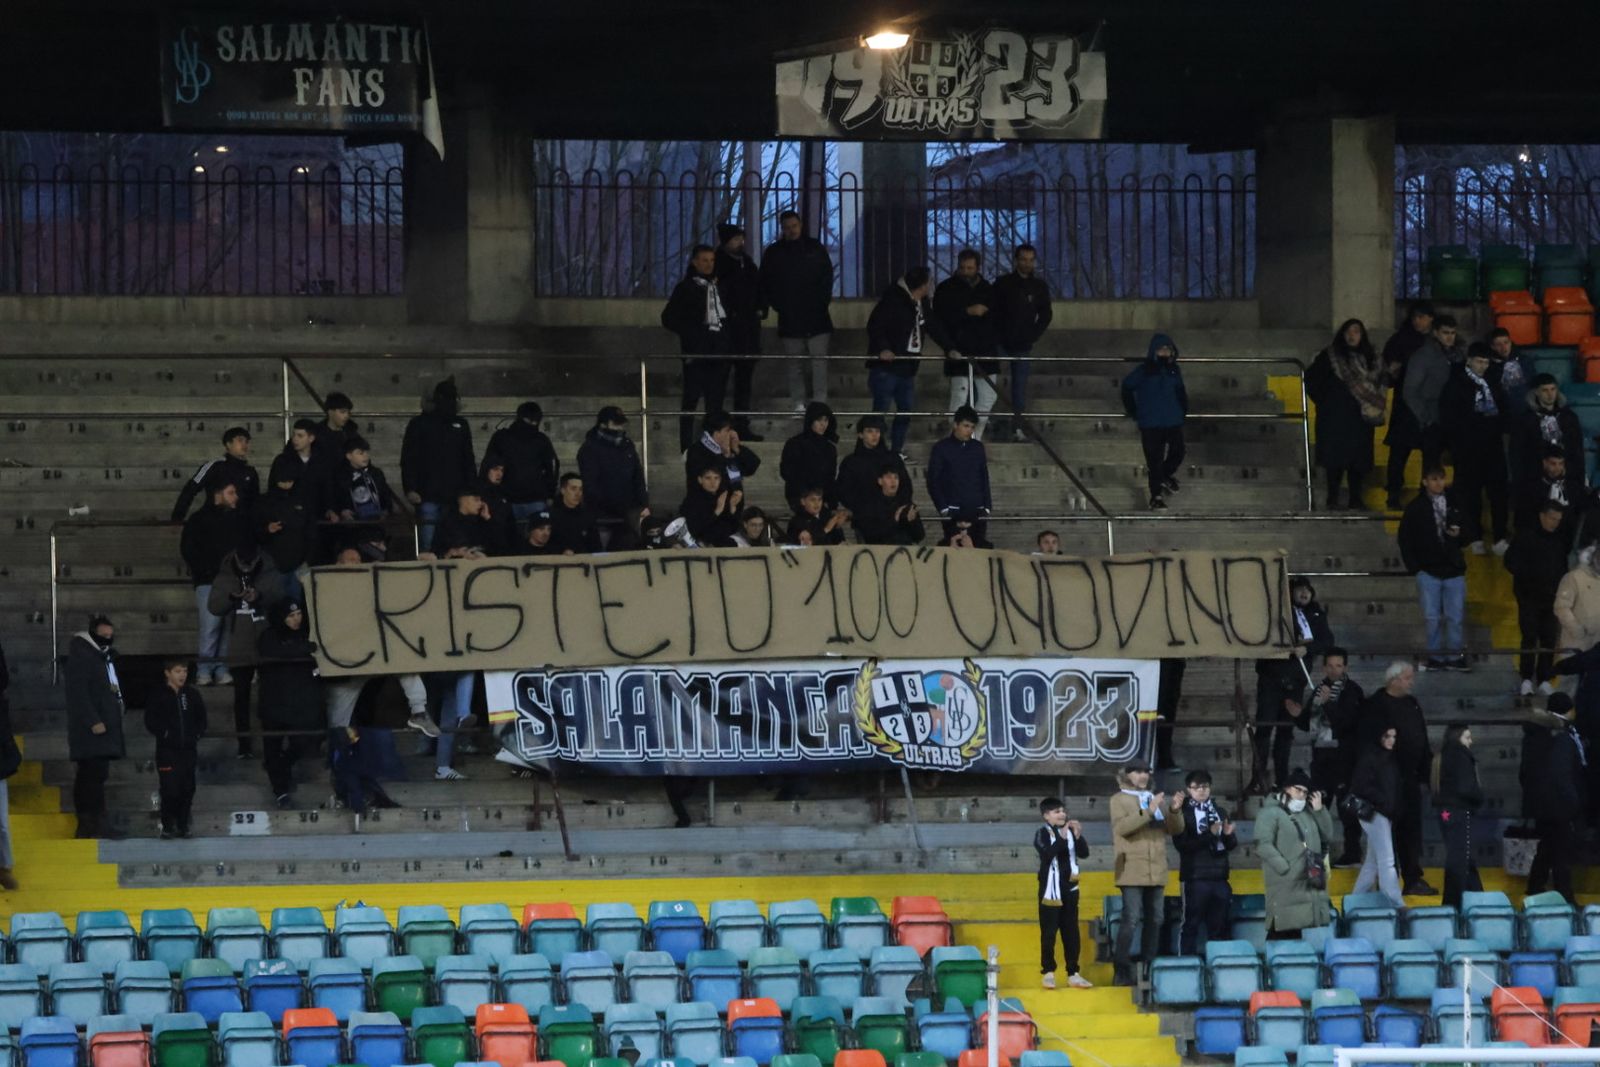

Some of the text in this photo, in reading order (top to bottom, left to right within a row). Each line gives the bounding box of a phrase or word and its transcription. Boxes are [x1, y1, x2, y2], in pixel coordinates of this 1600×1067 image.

[293, 68, 385, 107] FANS
[886, 97, 977, 127] ULTRAS
[512, 670, 1139, 761] SALAMANCA 1923
[903, 746, 963, 767] ULTRAS
